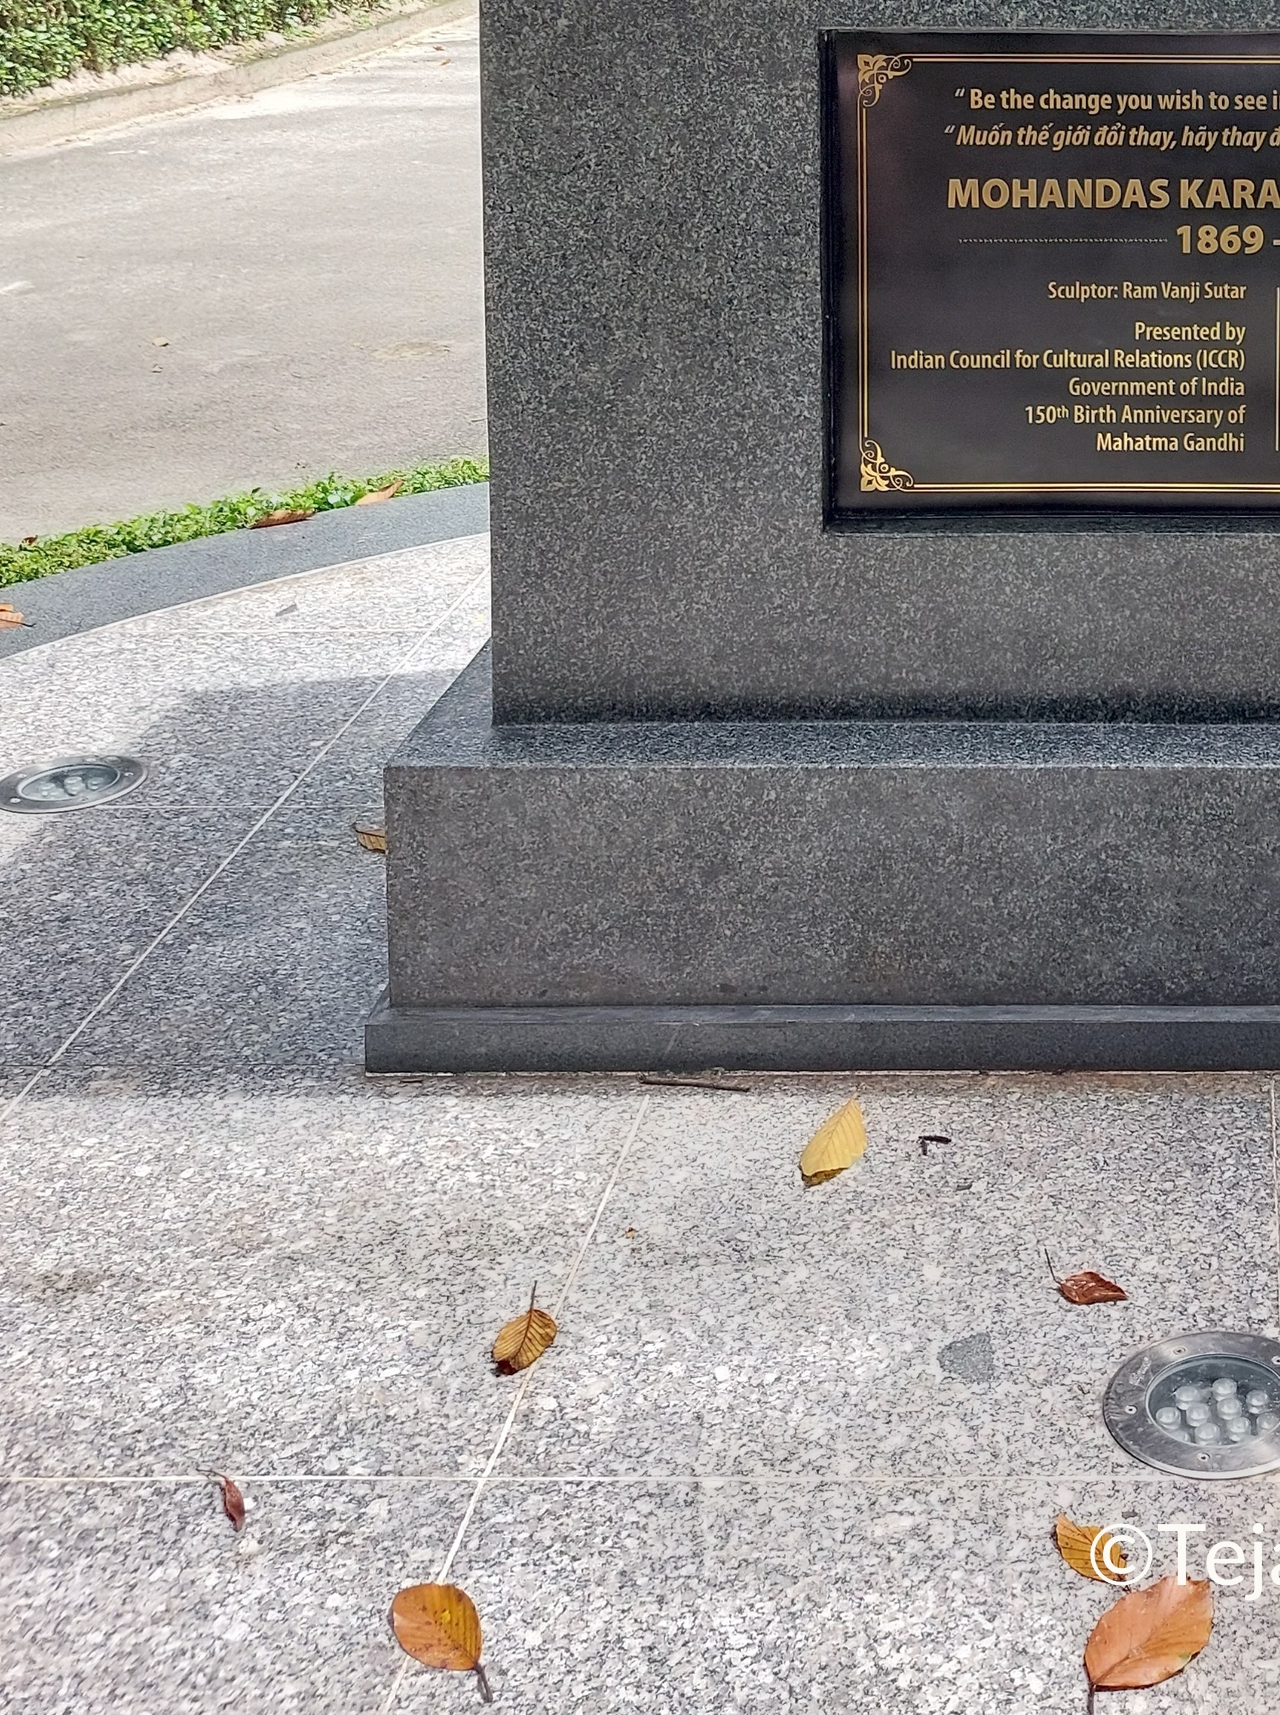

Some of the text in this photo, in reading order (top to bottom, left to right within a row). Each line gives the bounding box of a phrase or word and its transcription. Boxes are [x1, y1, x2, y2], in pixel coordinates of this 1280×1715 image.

[999, 88, 1035, 109] the
[1039, 88, 1113, 115] change
[1116, 94, 1153, 115] you
[1157, 88, 1204, 110] wish
[1208, 91, 1230, 110] to
[1234, 94, 1268, 110] see
[1016, 122, 1056, 146] thế
[1052, 125, 1092, 151] giới
[1093, 122, 1126, 146] đổi
[1128, 125, 1177, 151] thay,
[1181, 125, 1219, 152] hãy
[1221, 125, 1268, 152] thay
[947, 178, 1170, 209] MOHANDAS
[1176, 224, 1264, 254] 1869
[1047, 281, 1247, 304] Sculptor: Ram Vanji Sutar
[1134, 321, 1247, 345] Presented by
[891, 348, 1245, 372] Indian Council for Cultural Relations (ICCR)
[1068, 376, 1245, 396] Government of India
[1073, 404, 1117, 424] Birth
[1120, 404, 1224, 429] Anniversary
[1227, 404, 1247, 424] of
[1096, 431, 1245, 453] Mahatma Gandhi
